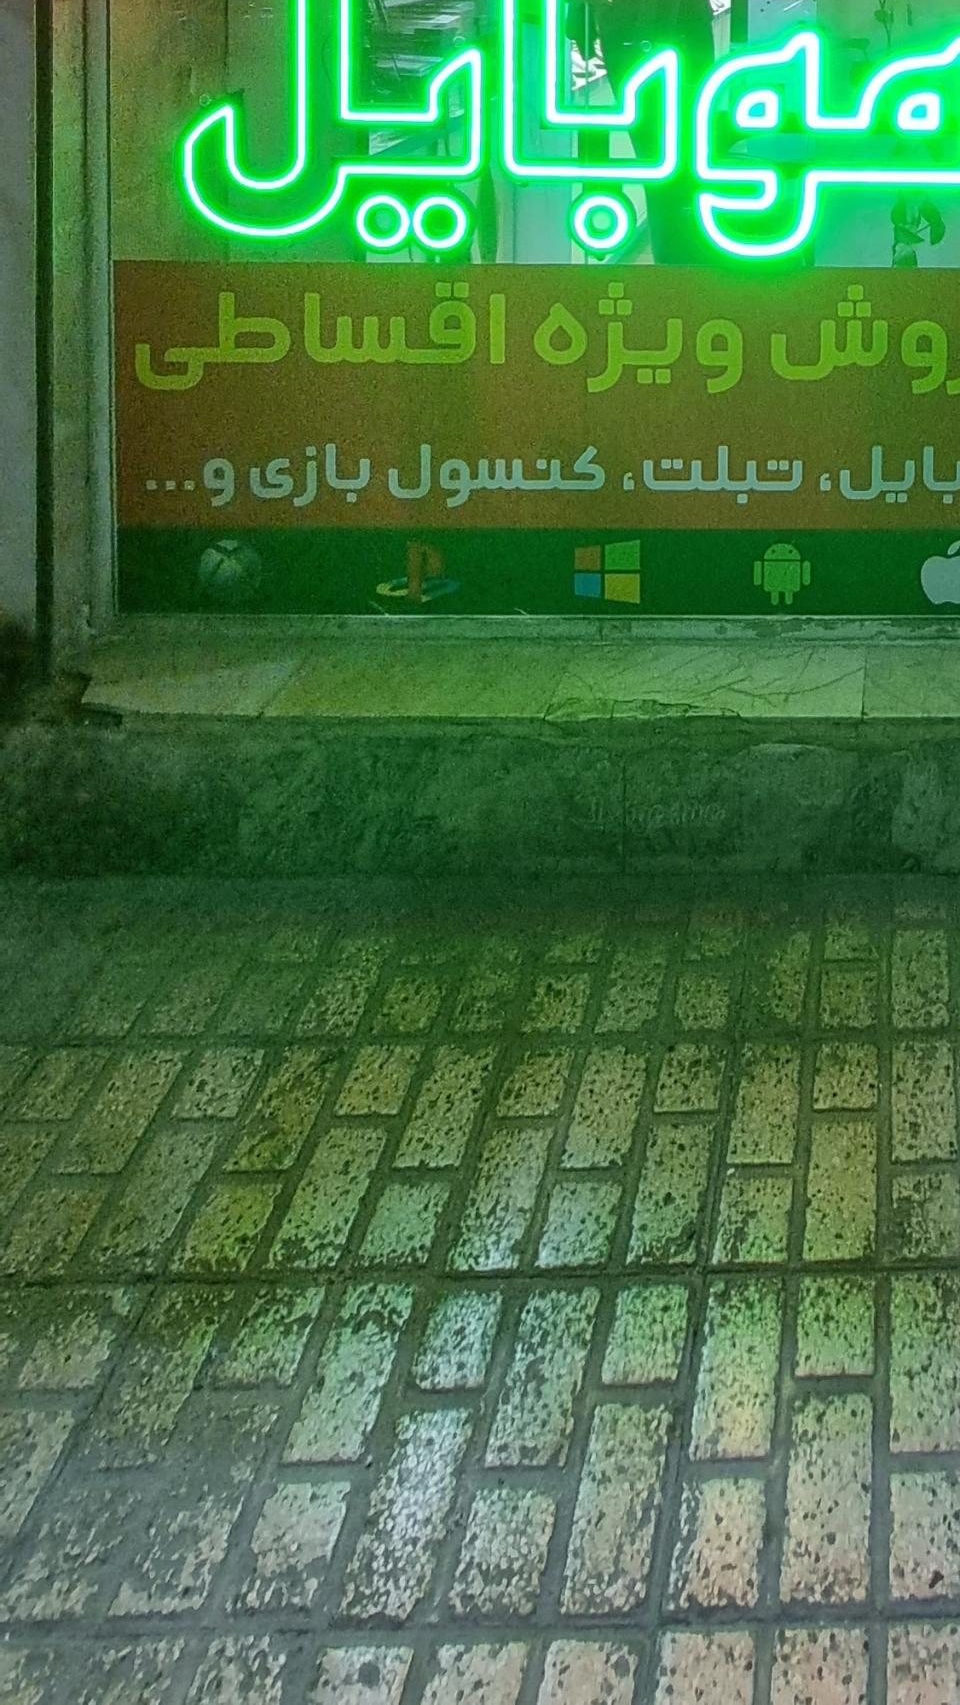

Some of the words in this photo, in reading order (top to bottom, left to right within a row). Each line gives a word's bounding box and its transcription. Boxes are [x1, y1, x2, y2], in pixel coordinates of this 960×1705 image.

[134, 281, 506, 391] اقساطی
[533, 282, 744, 394] ویژه
[249, 443, 371, 507] بازی
[388, 443, 606, 508] کنسول
[623, 445, 804, 505] تبلت،
